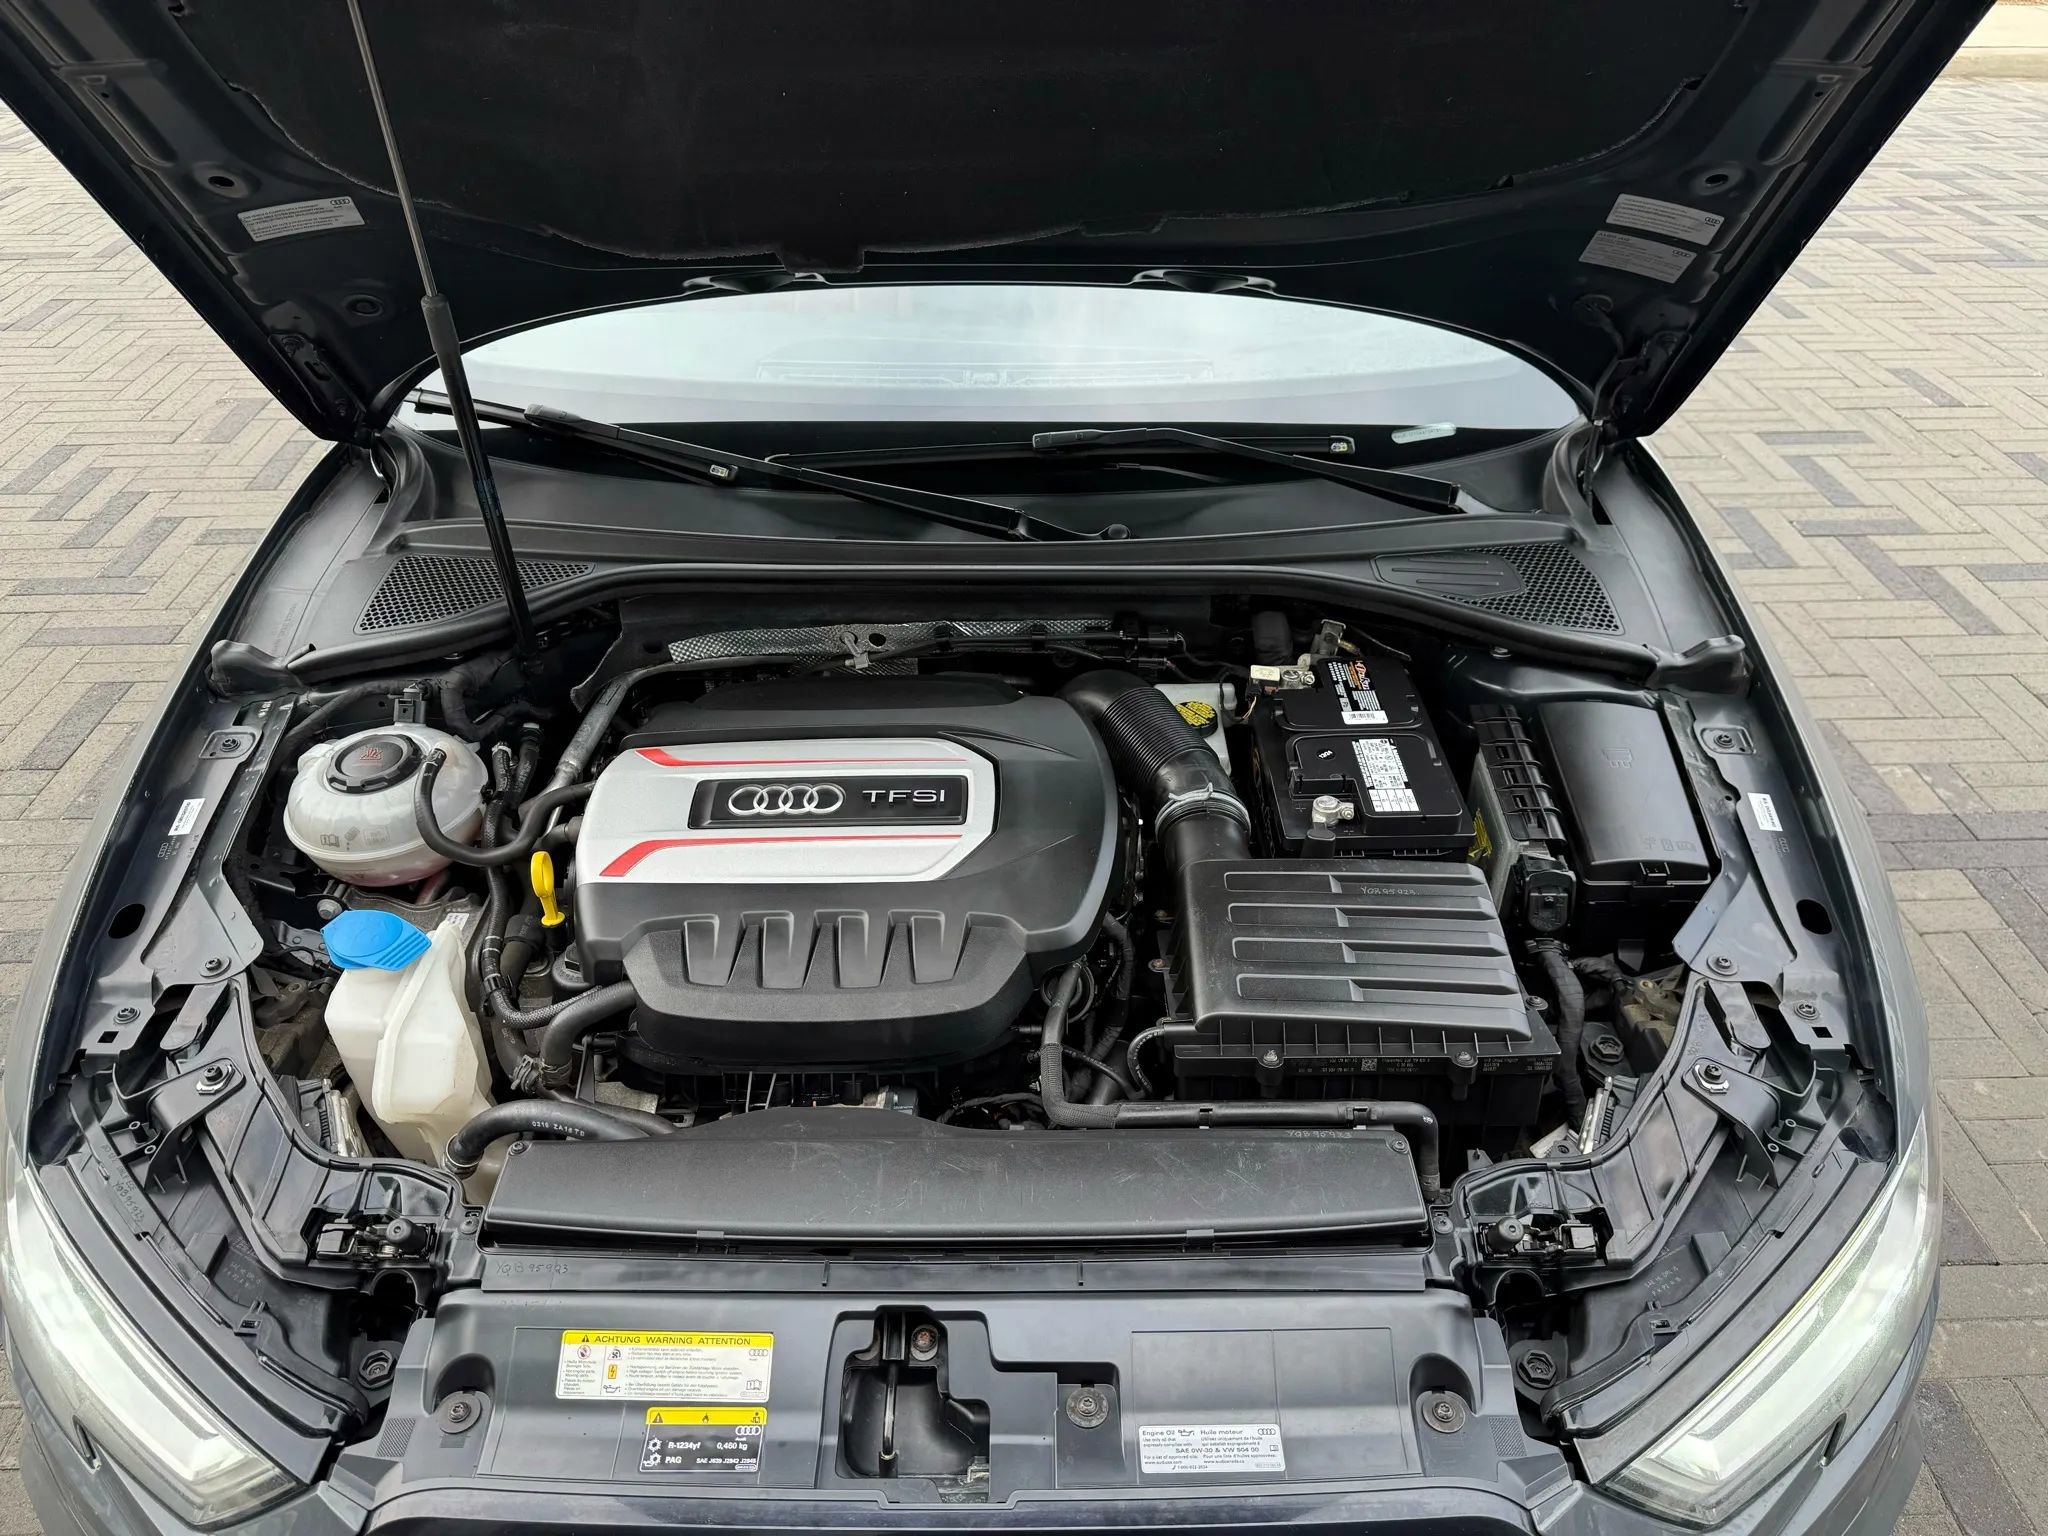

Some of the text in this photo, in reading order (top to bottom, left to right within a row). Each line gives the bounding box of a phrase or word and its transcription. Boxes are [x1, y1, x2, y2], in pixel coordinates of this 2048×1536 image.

[862, 789, 945, 804] TFSI
[594, 1335, 751, 1346] ACHTUNG WARNING ATTENTION
[668, 1441, 701, 1451] R-1234yf
[738, 1442, 748, 1450] kg
[665, 1456, 682, 1464] PAG
